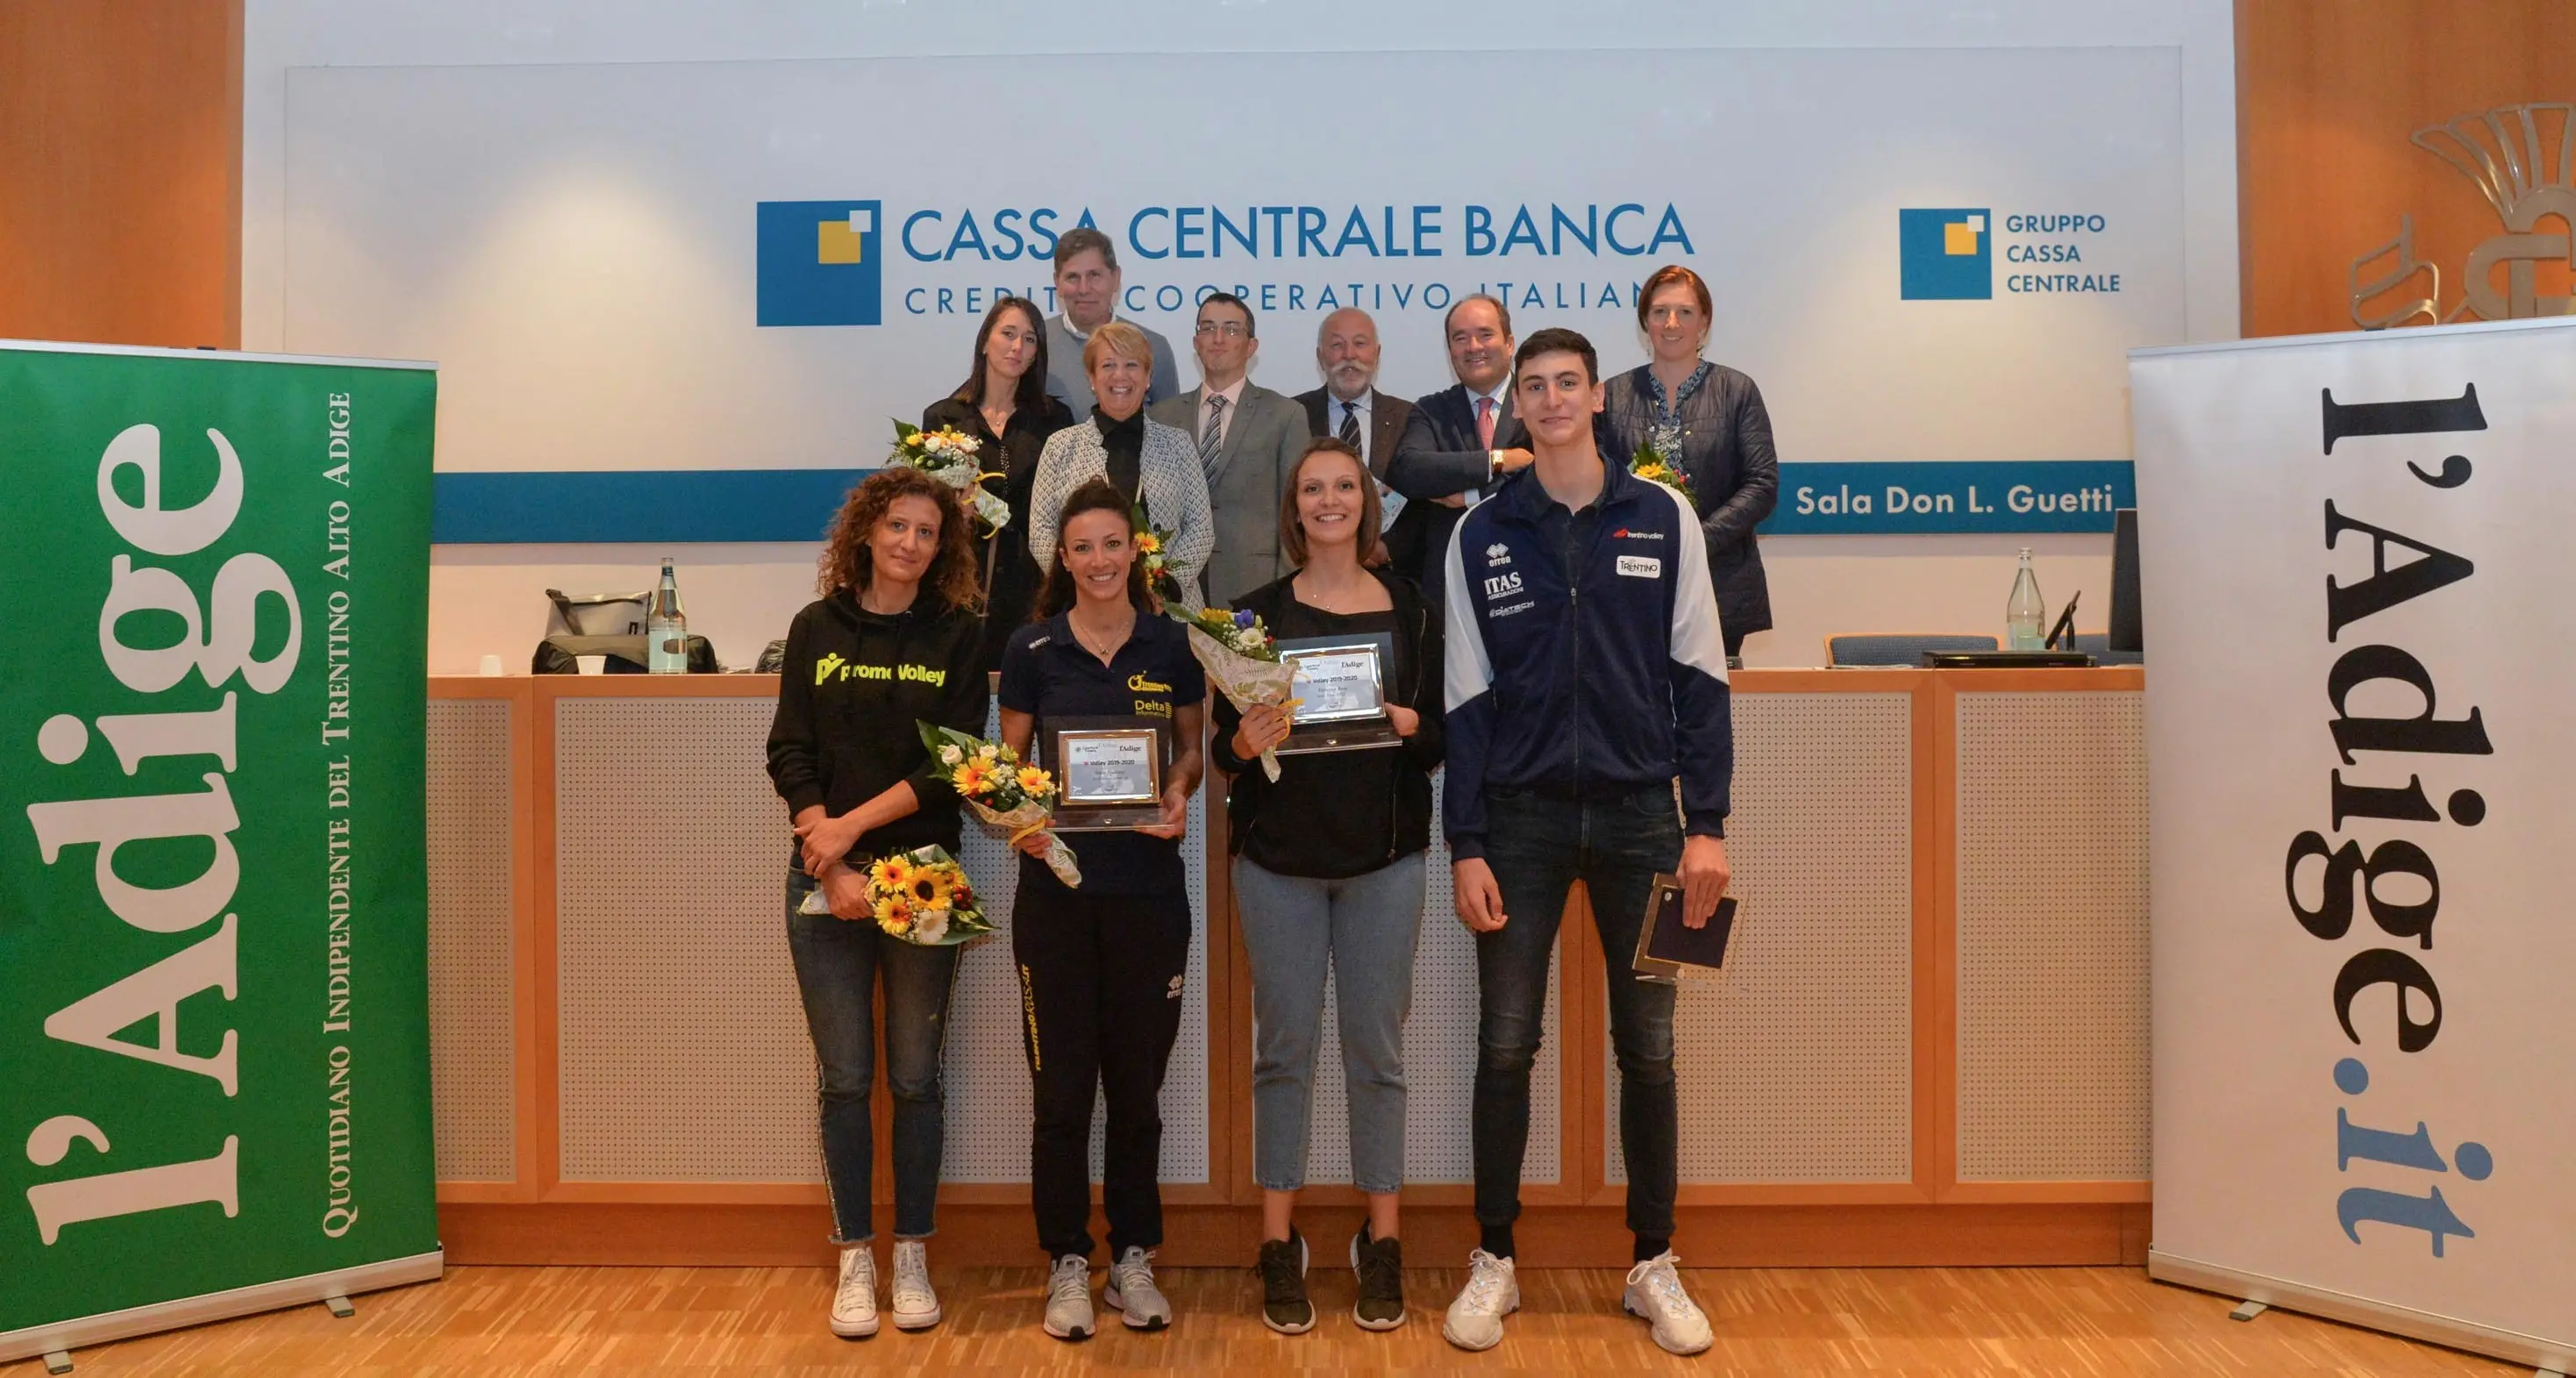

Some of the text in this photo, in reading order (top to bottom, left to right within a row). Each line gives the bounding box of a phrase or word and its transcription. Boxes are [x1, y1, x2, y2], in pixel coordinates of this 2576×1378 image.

[1128, 203, 1443, 260] CENTRALE
[1465, 203, 1695, 258] BANCA
[2007, 215, 2106, 232] GRUPPO
[2007, 245, 2080, 262] CASSA
[2007, 275, 2121, 292] CENTRALE
[906, 283, 1058, 314] CREIT
[1481, 282, 1643, 310] TALIA
[1795, 483, 2113, 515] Sala Don L. Guetti
[1619, 560, 1659, 574] TRENTINO
[1484, 571, 1523, 595] ITAS
[1135, 699, 1165, 712] Delta
[321, 391, 359, 1238] QUOTIDIANO INDIPENDENTE DEL TRENTINO ALTO ADIGE
[2285, 382, 2494, 1258] l'Adige.it
[26, 423, 303, 1246] l'Adige
